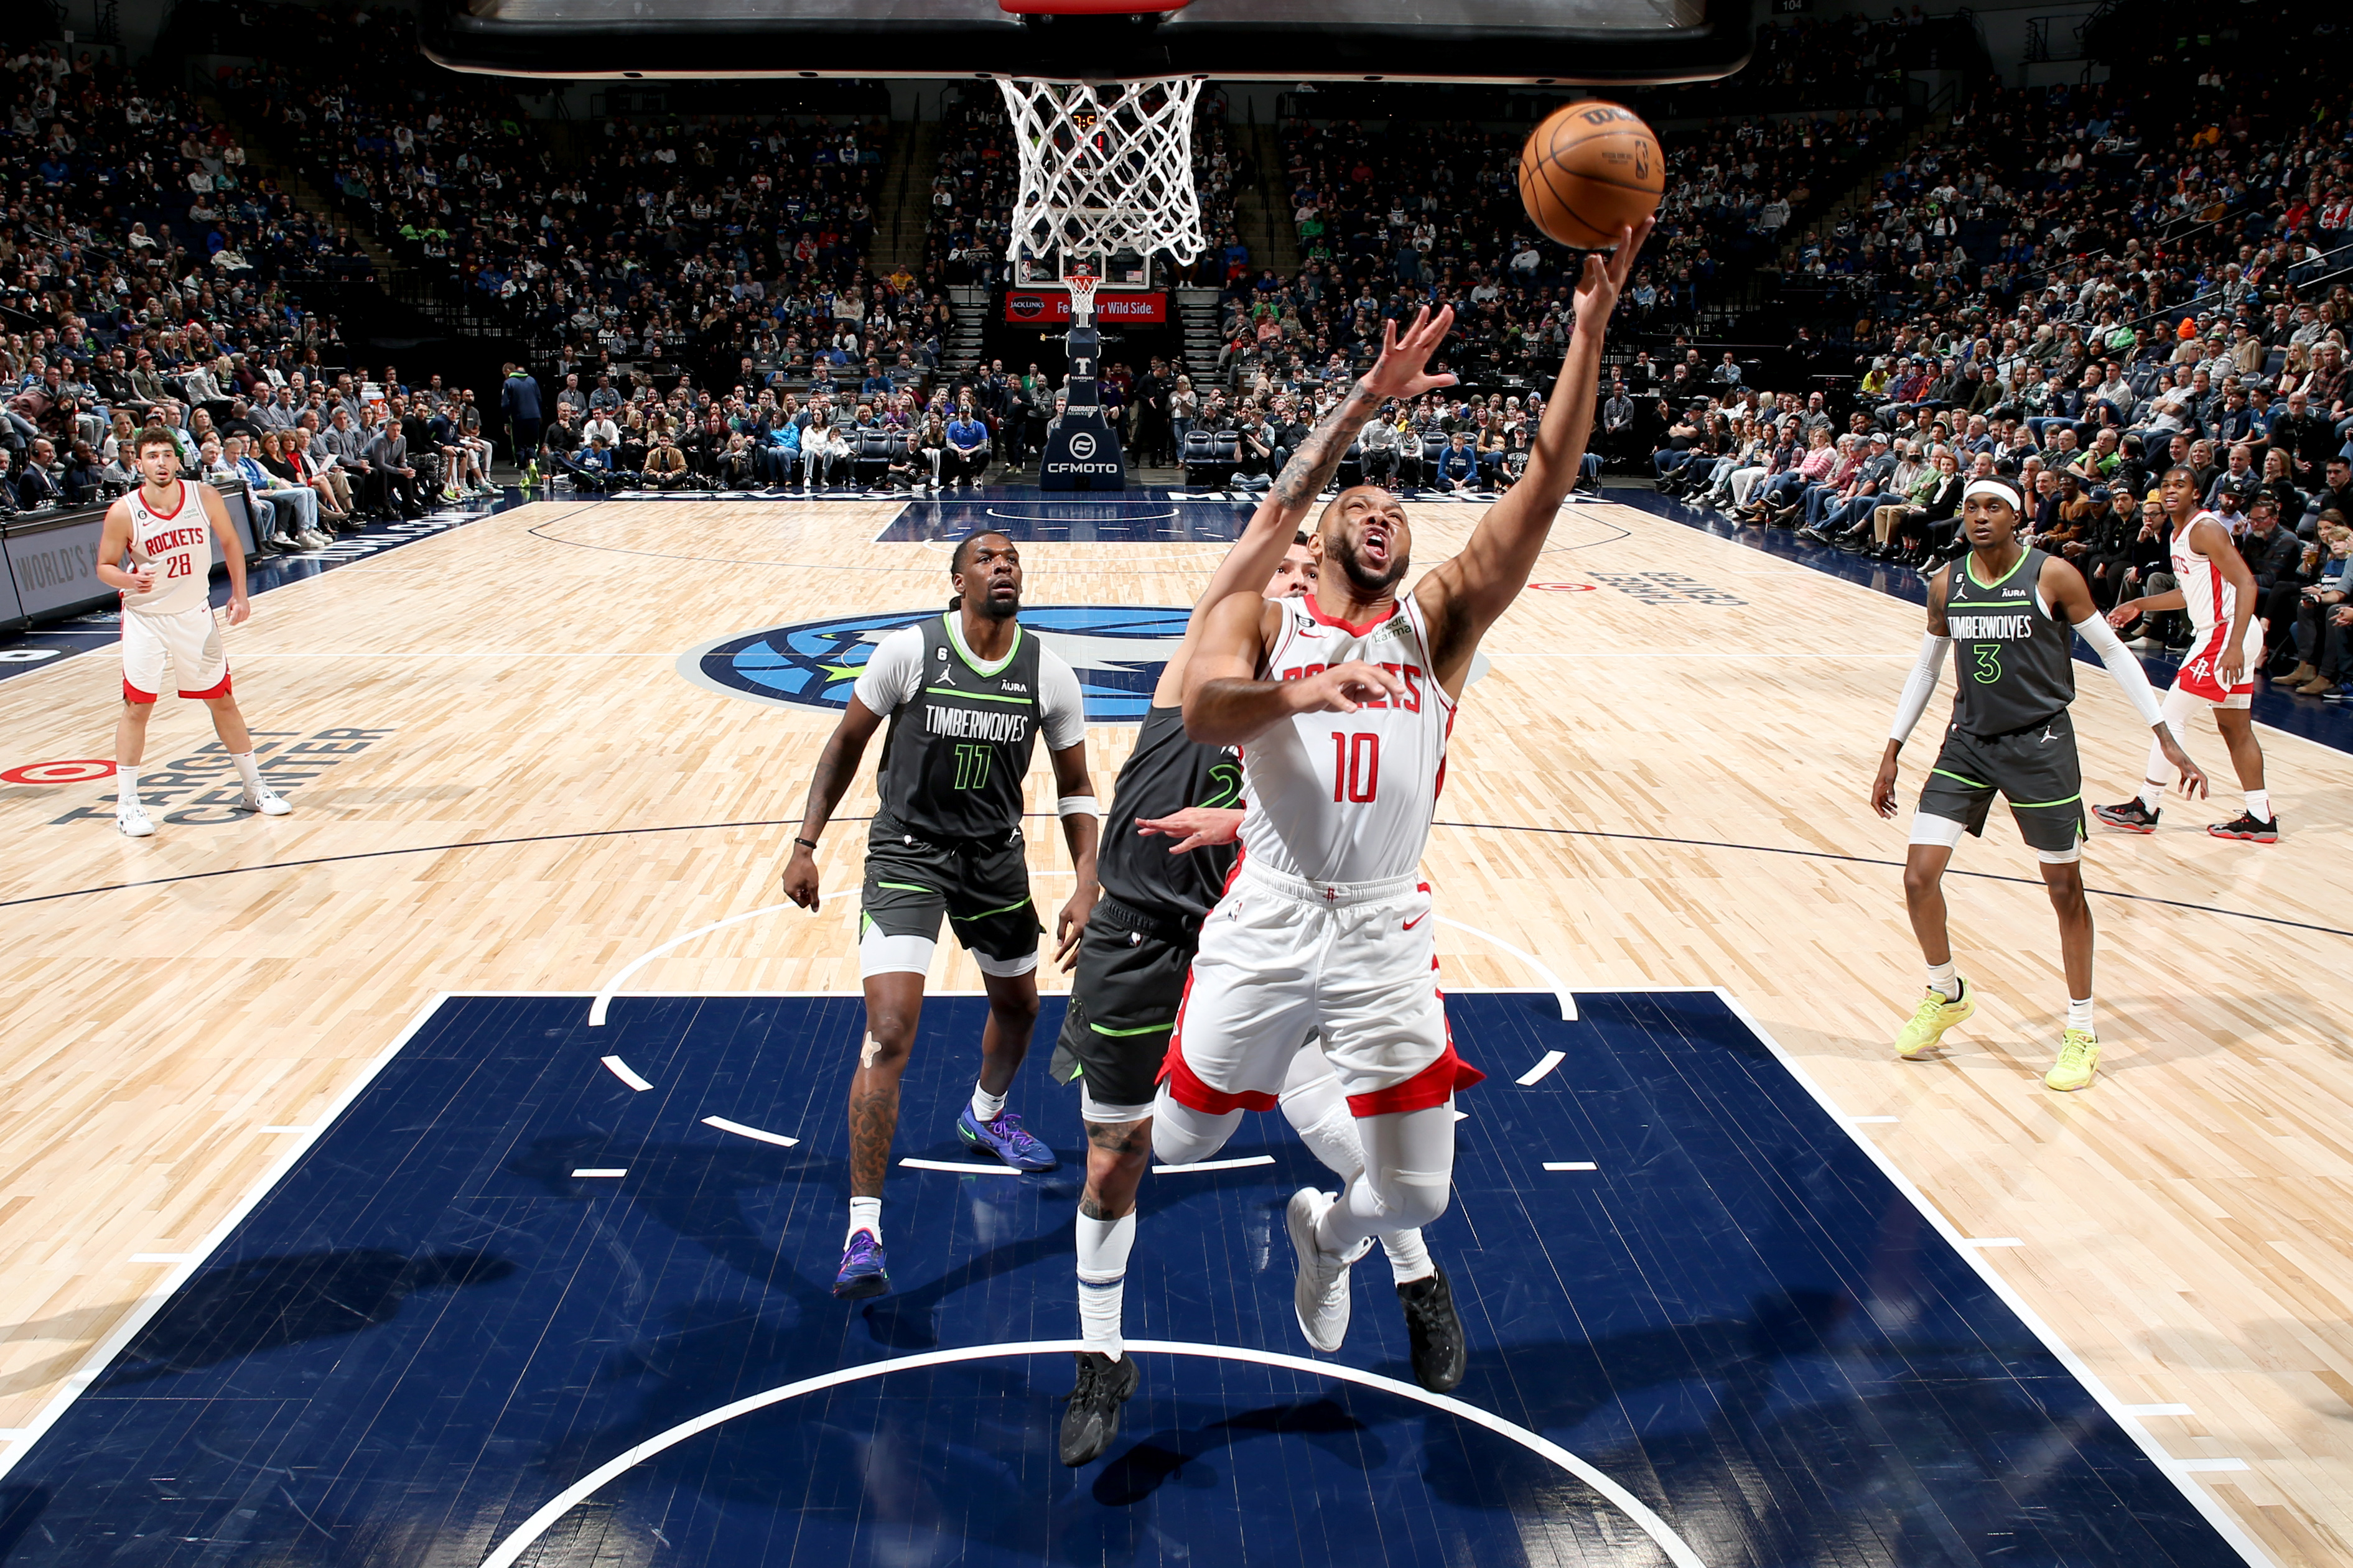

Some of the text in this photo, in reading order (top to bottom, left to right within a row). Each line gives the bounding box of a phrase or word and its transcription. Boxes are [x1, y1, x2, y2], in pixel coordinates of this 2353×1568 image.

[1107, 302, 1129, 314] Wild
[1130, 302, 1154, 315] Side.
[1048, 463, 1117, 473] CFMOTO
[144, 527, 204, 557] ROCKETS
[16, 544, 88, 591] WORLD'S
[166, 553, 192, 578] 28
[1955, 573, 1964, 583] 6
[1584, 572, 1690, 605] TARGET
[1638, 572, 1750, 606] CENTER
[1374, 625, 1412, 644] karma
[1947, 615, 2033, 643] TIMBERWOLVES
[937, 647, 949, 661] 6
[1973, 644, 2003, 685] 3
[925, 703, 1029, 746] TIMBERWOLVES
[954, 743, 992, 791] 11
[1331, 731, 1379, 802] 10
